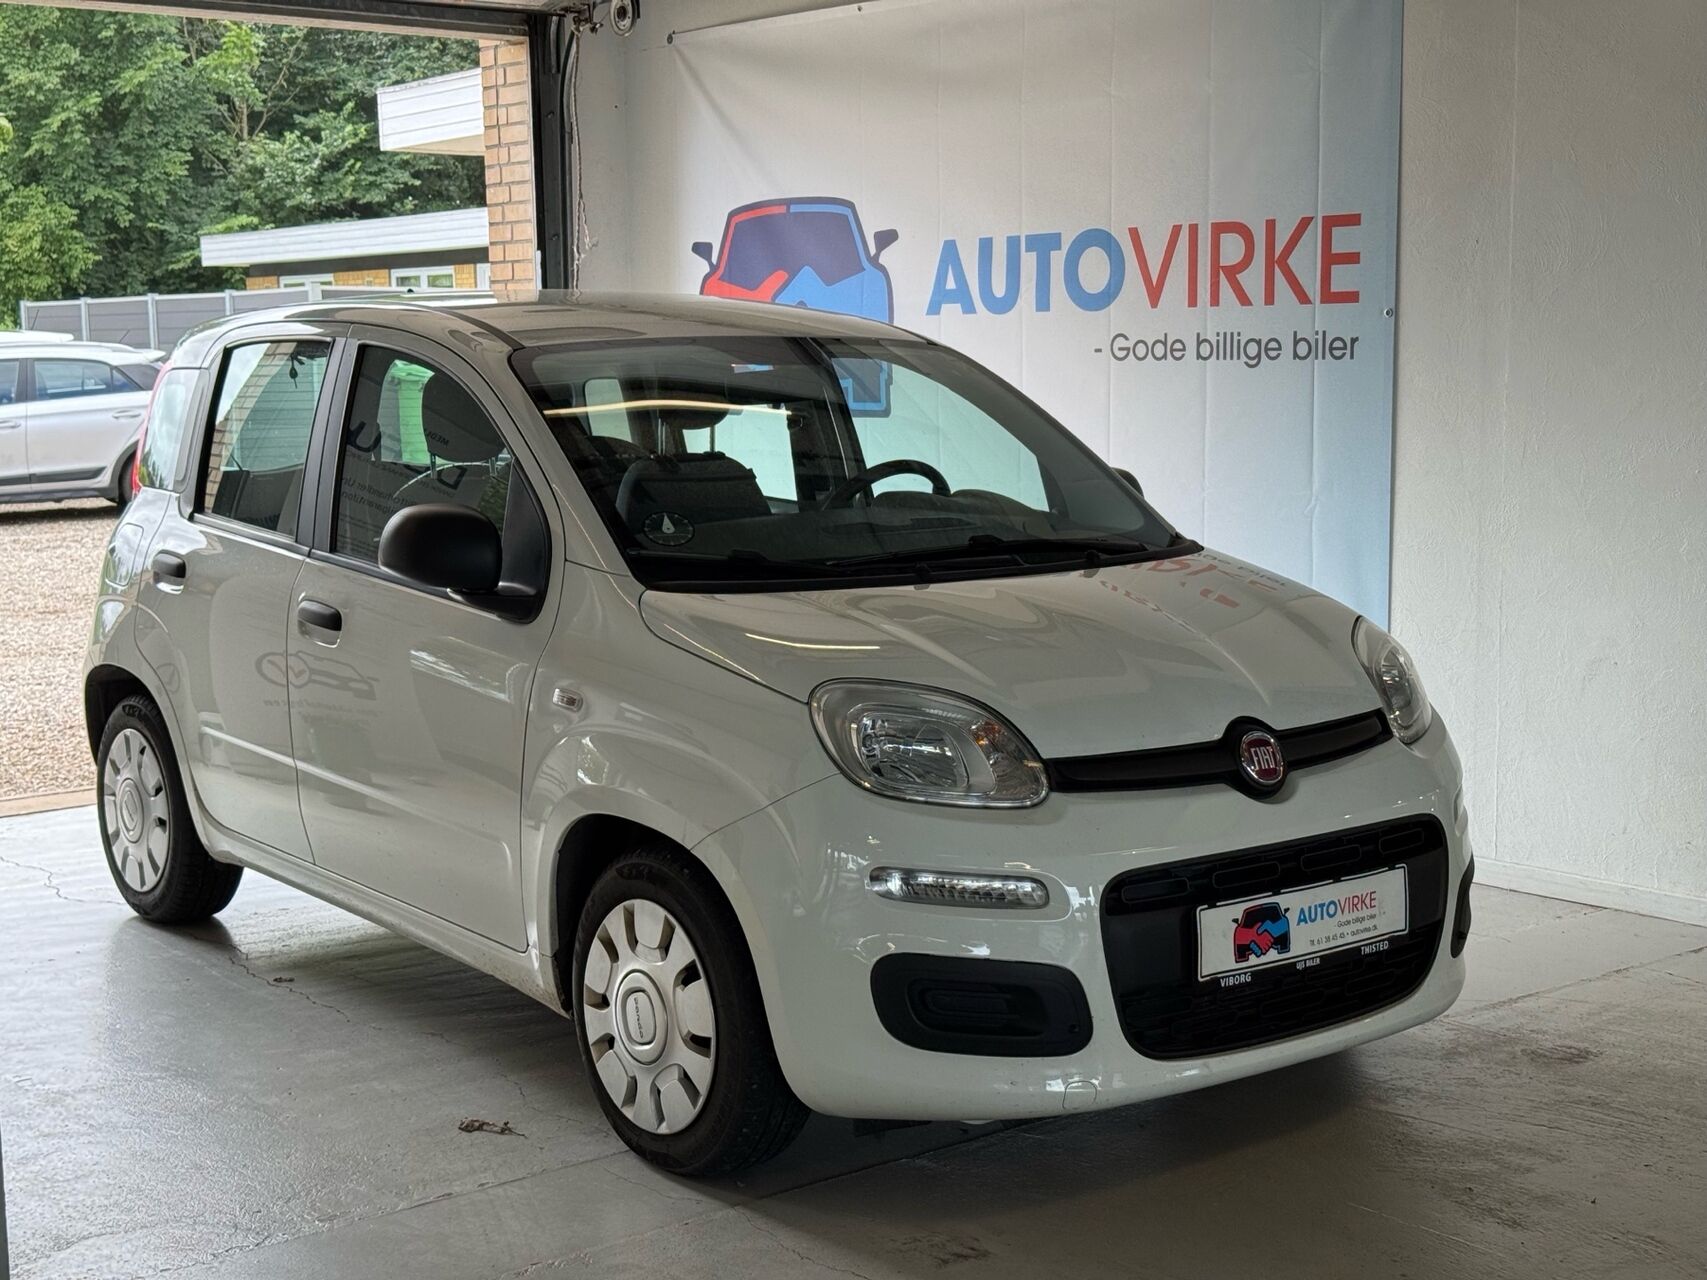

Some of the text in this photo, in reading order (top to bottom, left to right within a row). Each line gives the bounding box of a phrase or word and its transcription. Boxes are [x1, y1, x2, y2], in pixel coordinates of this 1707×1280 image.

[926, 213, 1362, 316] AUTOVIRKE
[1110, 333, 1186, 361] Gode
[1195, 331, 1283, 369] billige
[1292, 330, 1359, 361] biler
[1250, 746, 1276, 771] FIAT
[1296, 891, 1377, 927] AUTOVIRKE
[1337, 918, 1352, 928] Gode
[1366, 913, 1377, 921] biler
[1360, 941, 1389, 956] THISTED
[1306, 957, 1321, 968] BILER
[1220, 973, 1252, 987] VIBORG
